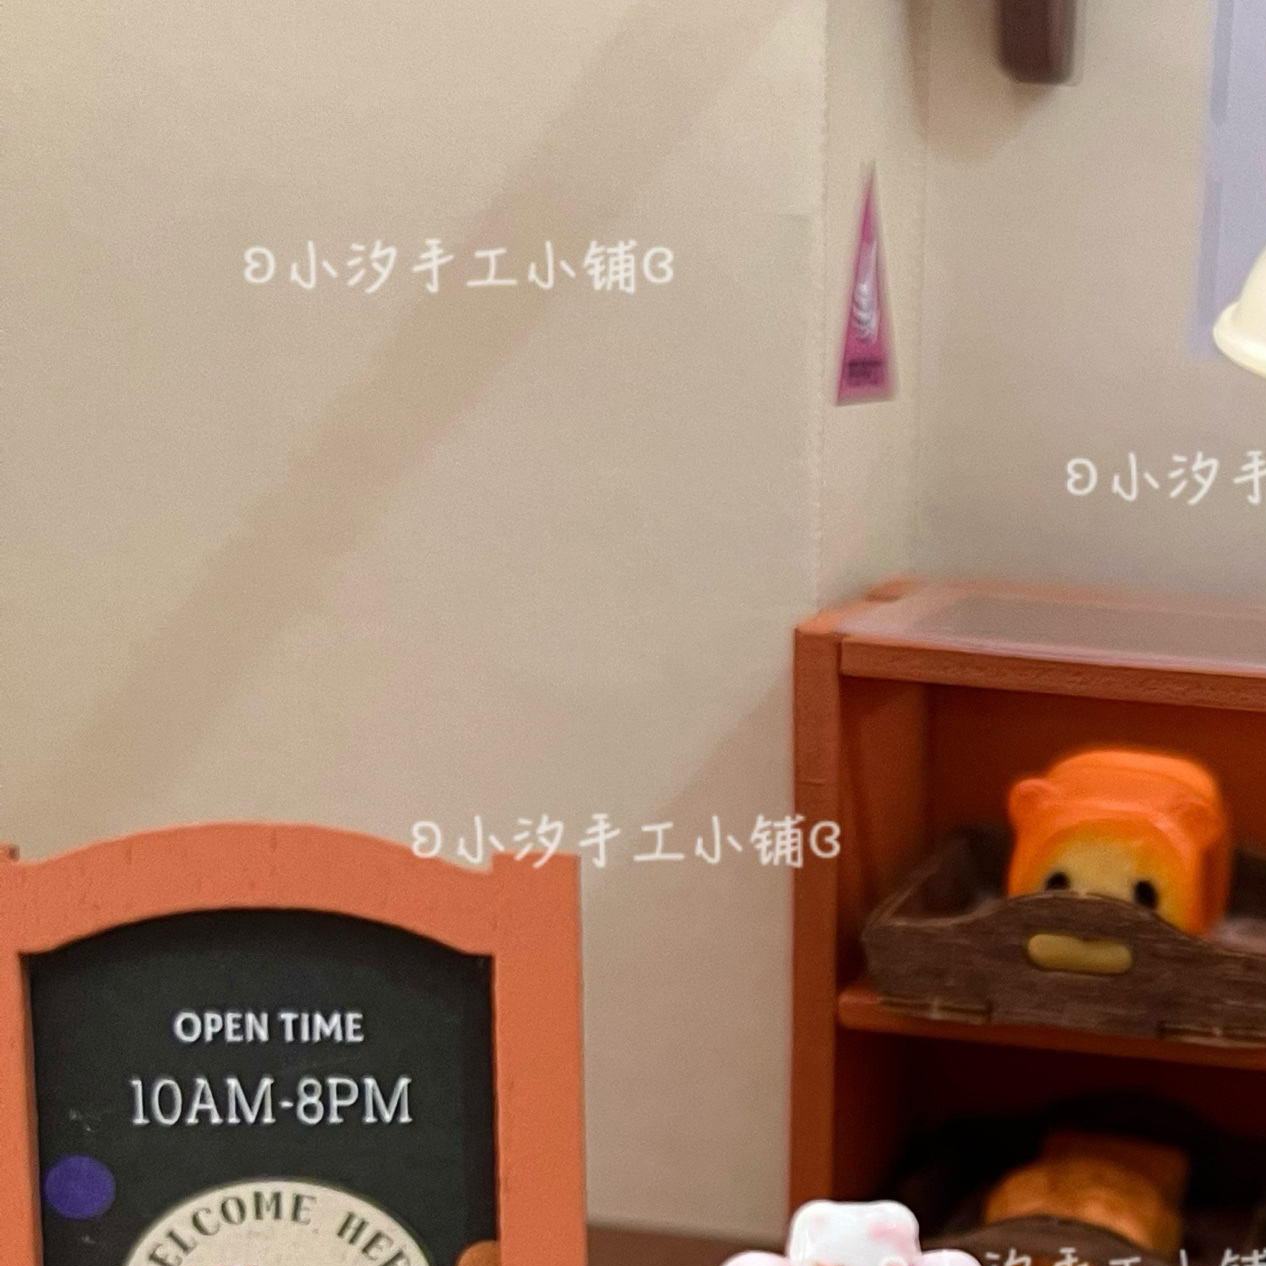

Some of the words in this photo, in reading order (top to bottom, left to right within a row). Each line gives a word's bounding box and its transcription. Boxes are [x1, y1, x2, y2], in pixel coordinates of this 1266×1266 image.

[174, 1011, 269, 1043] OPEN
[278, 1011, 364, 1043] TIME
[130, 1076, 412, 1126] 10AM-8PM
